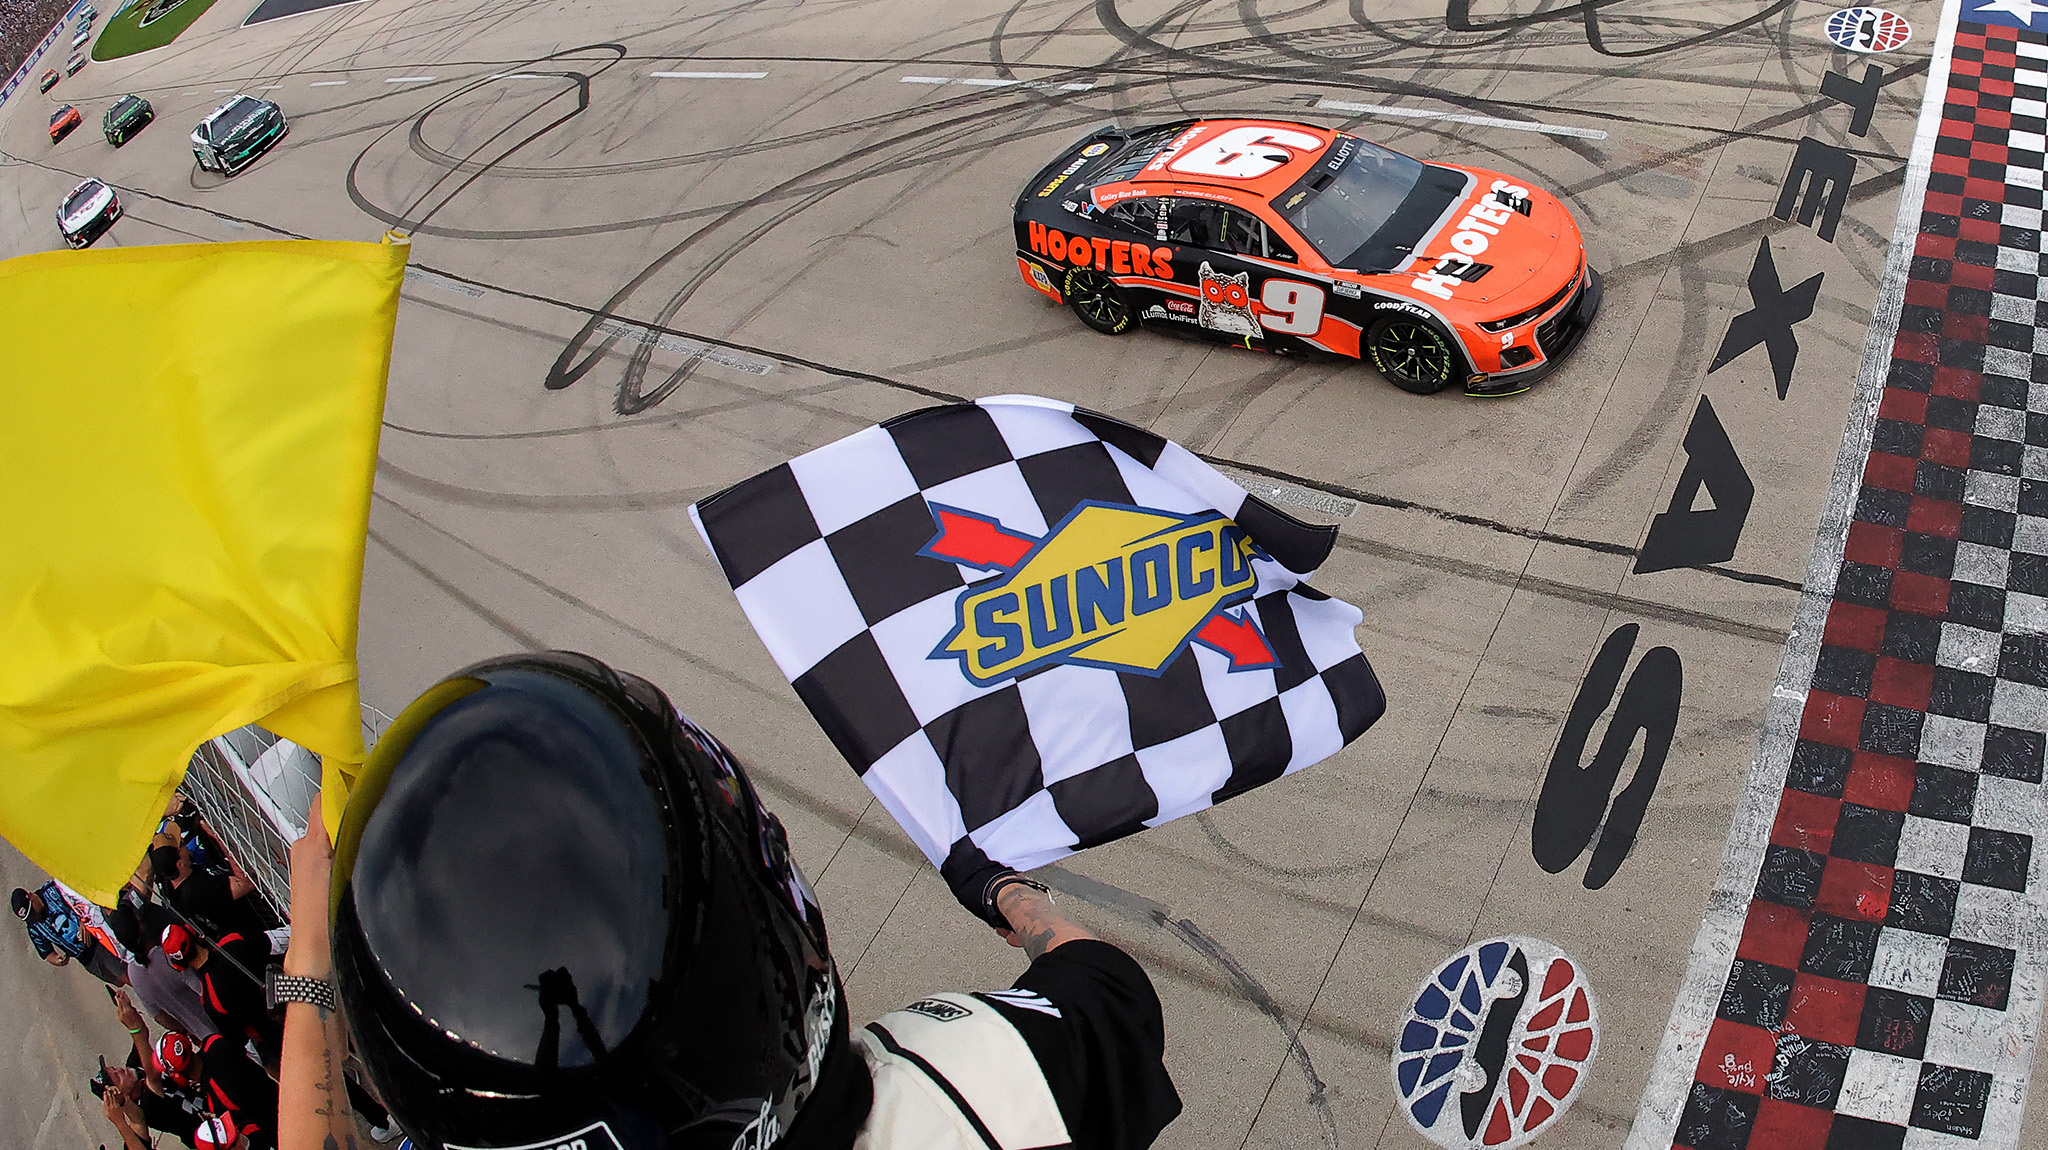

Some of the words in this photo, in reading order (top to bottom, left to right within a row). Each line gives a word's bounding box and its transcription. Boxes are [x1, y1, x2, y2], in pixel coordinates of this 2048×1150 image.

[1328, 141, 1355, 170] ELLIOTT
[1062, 157, 1089, 176] AUTO
[1038, 174, 1070, 197] PARTS
[1100, 192, 1118, 202] Kelley
[1118, 190, 1132, 199] Blue
[1132, 188, 1147, 197] Book
[1204, 191, 1234, 201] ELLIOTT
[1029, 220, 1174, 280] HOOTERS
[1411, 180, 1530, 301] HOOTERS
[1258, 278, 1326, 337] 9
[1373, 302, 1432, 320] GOODYEAR
[1169, 312, 1198, 325] UniFirst
[1501, 331, 1514, 350] 9
[1532, 64, 1884, 890] TEXAS
[973, 524, 1251, 670] SUNOCO
[1727, 1073, 1757, 1088] Kyle
